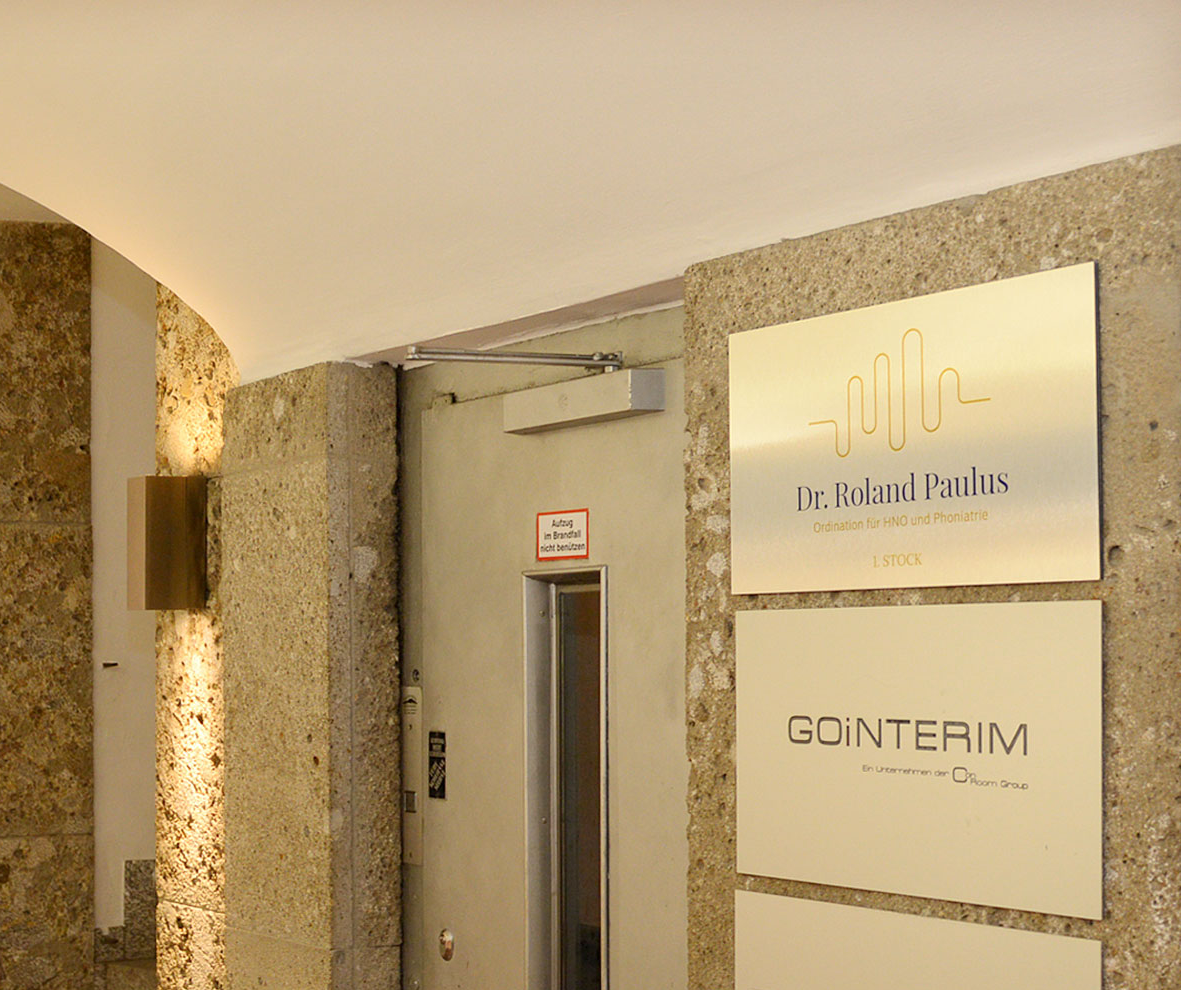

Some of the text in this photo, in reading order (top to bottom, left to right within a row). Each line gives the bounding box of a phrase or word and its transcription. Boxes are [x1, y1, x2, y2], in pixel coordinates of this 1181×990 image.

[796, 466, 1009, 512] Dr. Roland Paulus
[813, 509, 989, 533] Ordination für HNO und Phoniatrie
[553, 529, 581, 540] Brandfall
[540, 544, 555, 552] nicht
[882, 552, 923, 567] STOCK
[862, 764, 874, 773] Ein
[876, 765, 932, 776] Unternehmen
[934, 768, 949, 777] der
[1000, 779, 1029, 790] Group
